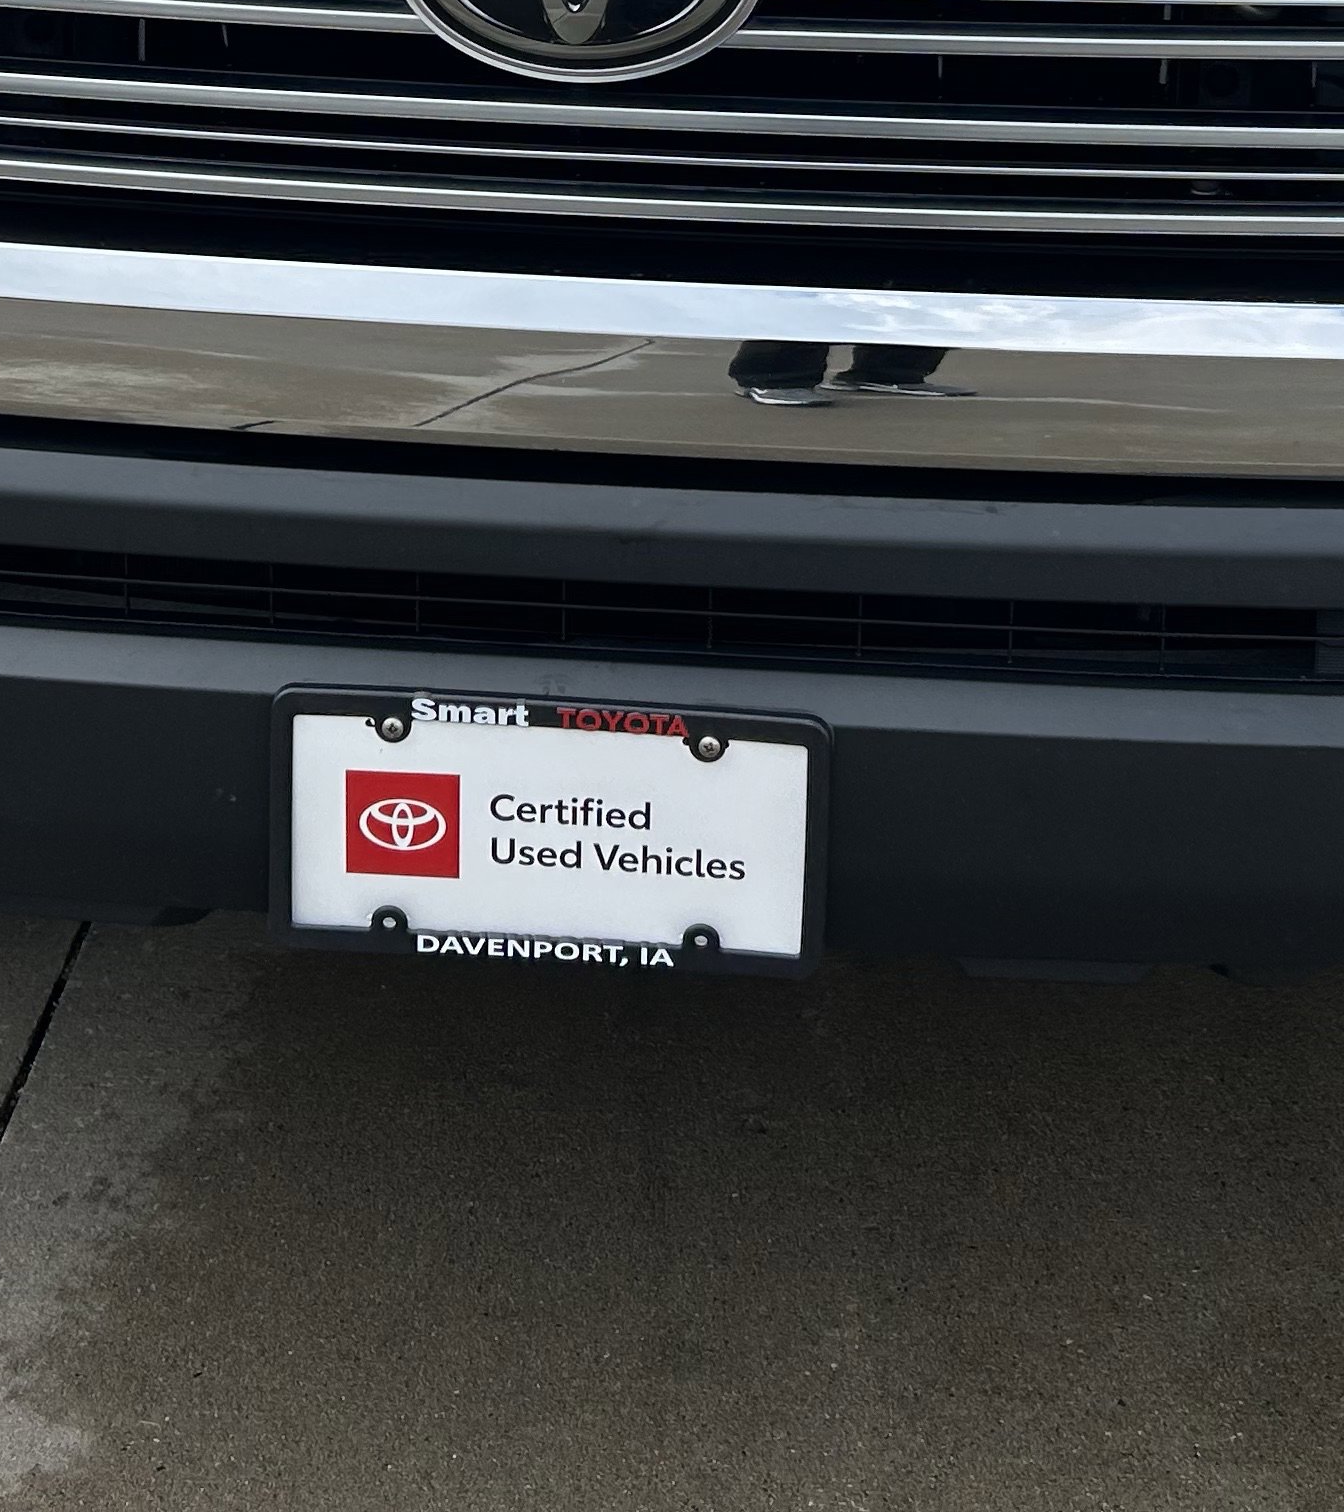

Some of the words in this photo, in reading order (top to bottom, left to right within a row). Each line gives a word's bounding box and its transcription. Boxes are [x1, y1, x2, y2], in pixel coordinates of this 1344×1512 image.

[411, 698, 530, 727] Smart
[556, 706, 690, 738] TOYOTA
[490, 793, 651, 830] Certified
[491, 836, 582, 869] Used
[593, 842, 746, 880] Vehicles
[416, 934, 630, 967] DAVENPORT,
[640, 946, 674, 967] IA
